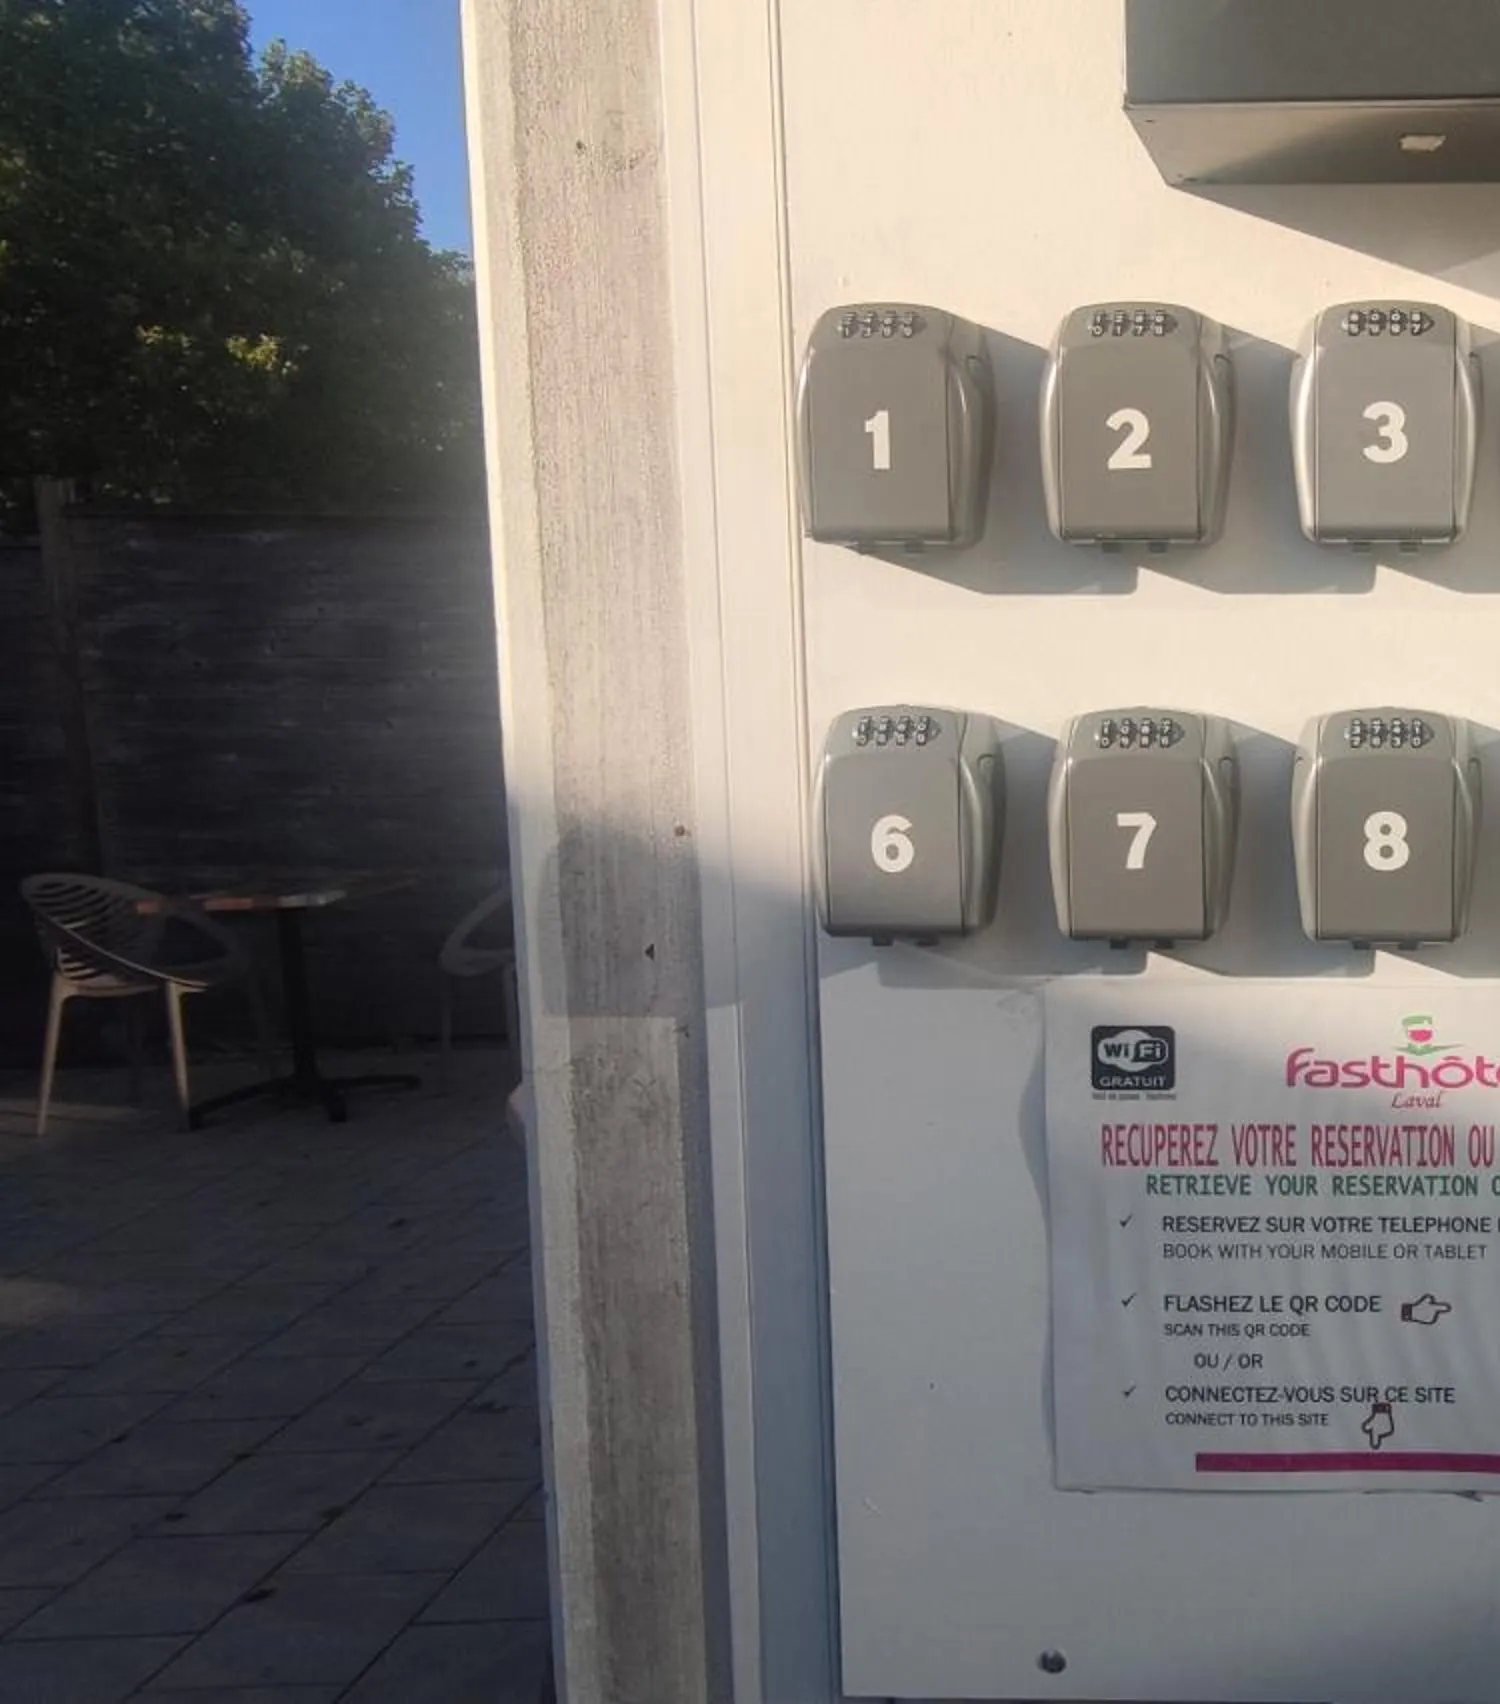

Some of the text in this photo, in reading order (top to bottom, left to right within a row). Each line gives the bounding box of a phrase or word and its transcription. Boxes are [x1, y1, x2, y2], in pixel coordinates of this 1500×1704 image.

[864, 409, 891, 469] 1
[1105, 408, 1152, 470] 2
[1362, 401, 1408, 464] 3
[871, 815, 915, 873] 6
[1117, 812, 1157, 869] 7
[1363, 811, 1410, 871] 8
[1100, 1075, 1167, 1088] GRATUIT
[1391, 1091, 1444, 1109] Laval
[1101, 1123, 1219, 1167] RECUPEREZ
[1231, 1123, 1297, 1167] VOTRE
[1311, 1124, 1454, 1168] RESERVATION
[1468, 1125, 1495, 1168] OU
[1146, 1174, 1250, 1197] RETRIEVE
[1265, 1174, 1318, 1197] YOUR
[1332, 1175, 1478, 1197] RESERVATION
[1162, 1216, 1260, 1233] RESERVEZ
[1266, 1216, 1305, 1233] SUR
[1310, 1216, 1373, 1233] VOTRE
[1378, 1216, 1490, 1233] TELEPHONE
[1163, 1244, 1487, 1260] BOOK WITH YOUR MOBILE OR TABLET
[1164, 1295, 1382, 1314] FLASHEZ LE QR CODE
[1164, 1324, 1311, 1338] SCAN THIS QR CODE
[1194, 1353, 1219, 1369] OU
[1238, 1353, 1263, 1369] OR
[1165, 1386, 1456, 1403] CONNECTEZ-VOUS SUR CE SITE
[1165, 1412, 1329, 1426] CONNECT TO THIS SITE
